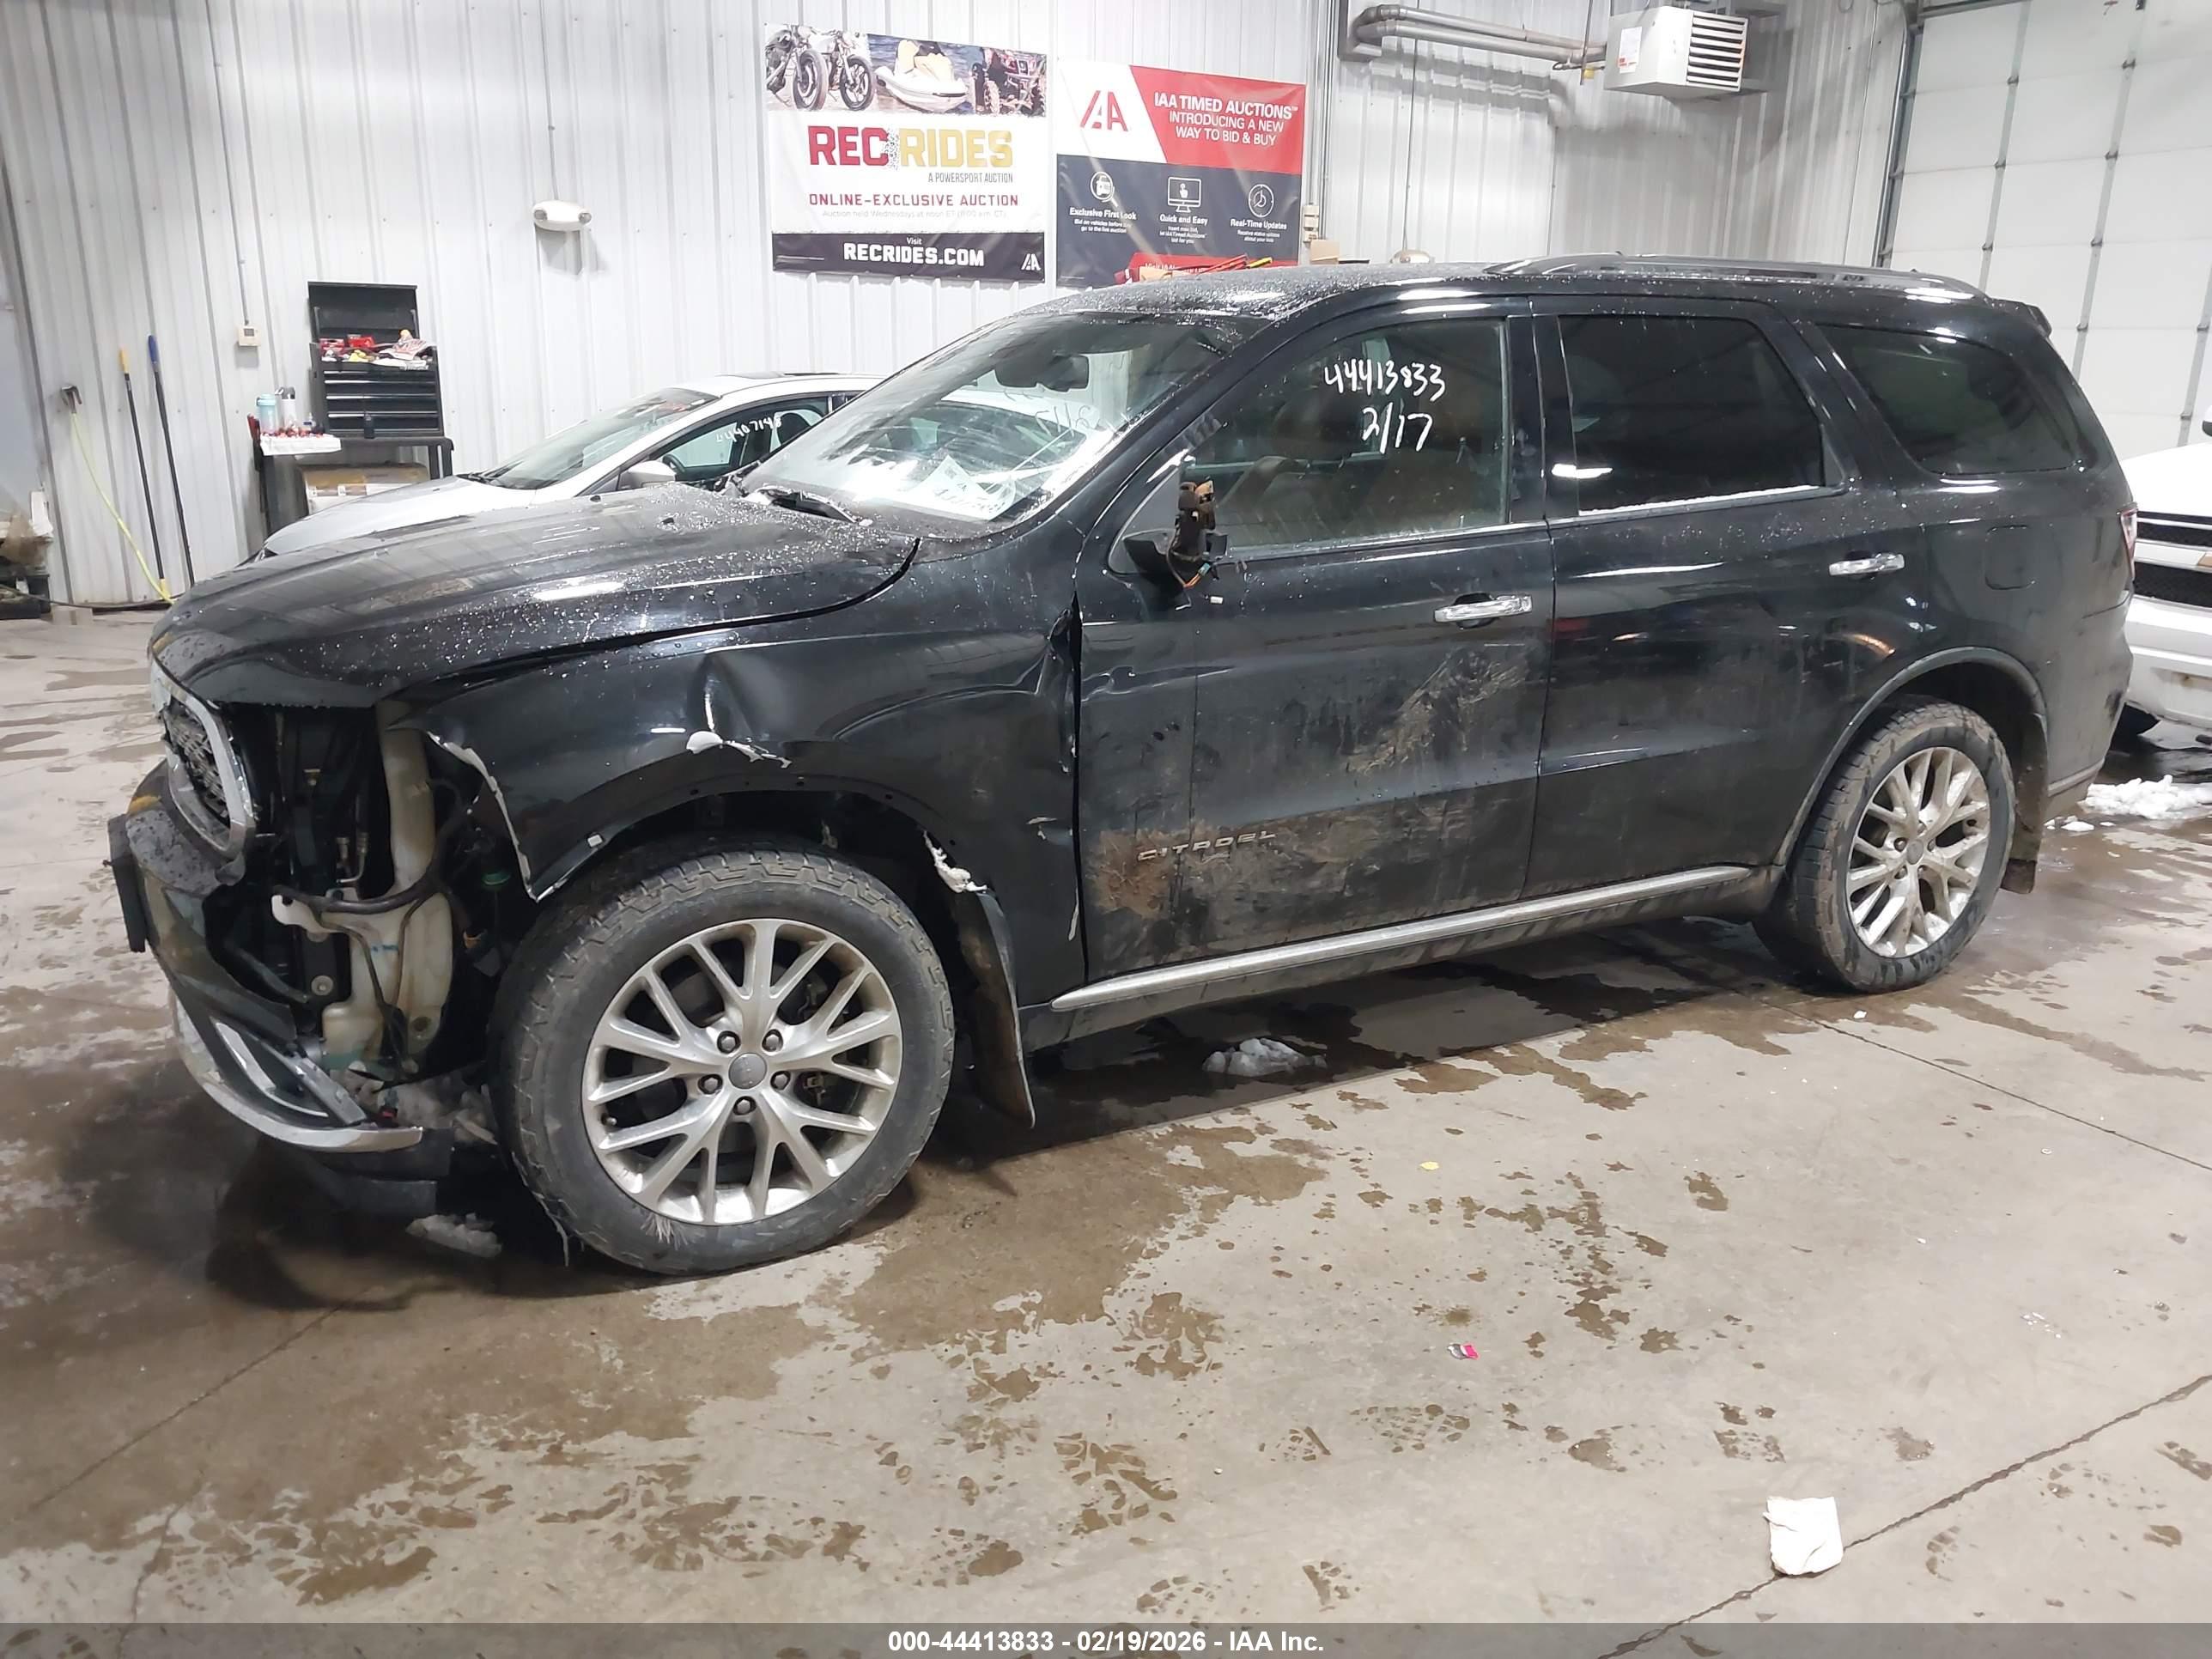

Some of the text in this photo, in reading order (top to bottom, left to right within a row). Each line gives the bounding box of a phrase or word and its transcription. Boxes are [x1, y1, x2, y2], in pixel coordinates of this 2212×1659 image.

[1154, 92, 1177, 108] IAA
[1179, 94, 1223, 112] TIMED
[1170, 111, 1284, 132] INTRODUCING A NEW
[1176, 125, 1277, 146] WAY TO BID & BUY
[807, 125, 1013, 168] REC RIDES
[927, 173, 1013, 184] A POWERSPORT AUCTION
[809, 194, 1019, 206] ONLINE-EXCLUSIVE AUCTION
[1069, 207, 1103, 218] Exclusive
[1104, 210, 1120, 218] First
[1159, 214, 1177, 223] Quick
[1193, 216, 1208, 226] Easy
[1230, 218, 1287, 230] Real-Time Updates
[843, 242, 985, 268] RECRIDES.COM
[1324, 358, 1446, 402] 44413833
[1362, 402, 1433, 455] 2/17
